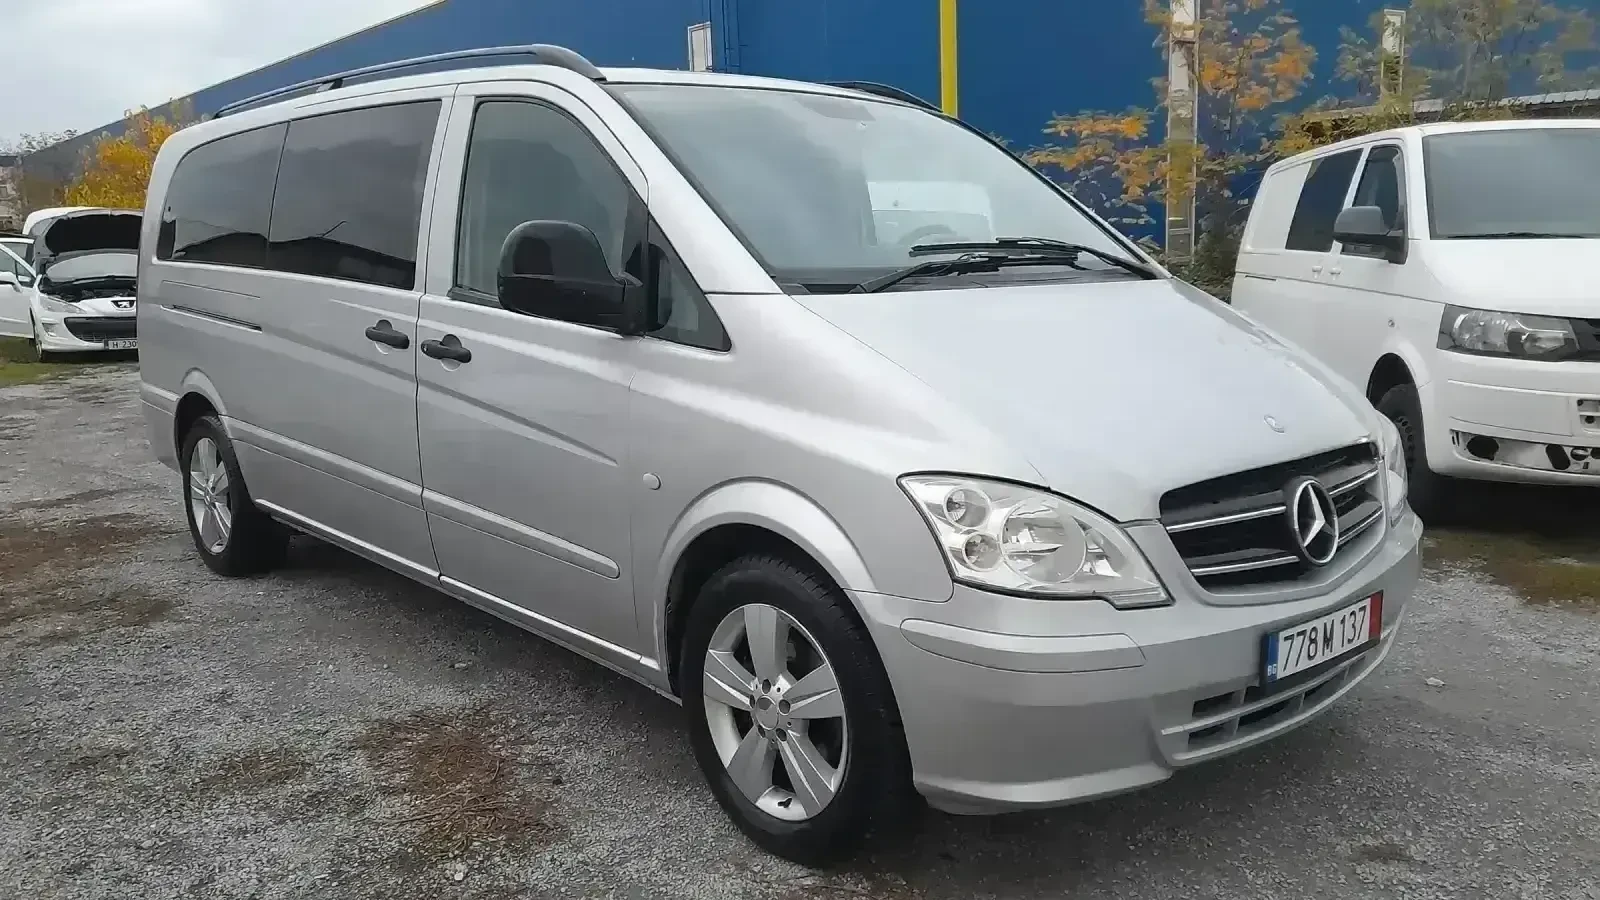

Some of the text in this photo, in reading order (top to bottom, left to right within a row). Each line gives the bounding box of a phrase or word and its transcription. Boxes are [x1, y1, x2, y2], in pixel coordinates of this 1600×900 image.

[122, 340, 138, 348] 230
[1283, 626, 1319, 672] 778
[1340, 605, 1368, 648] 137
[1267, 663, 1277, 676] BG
